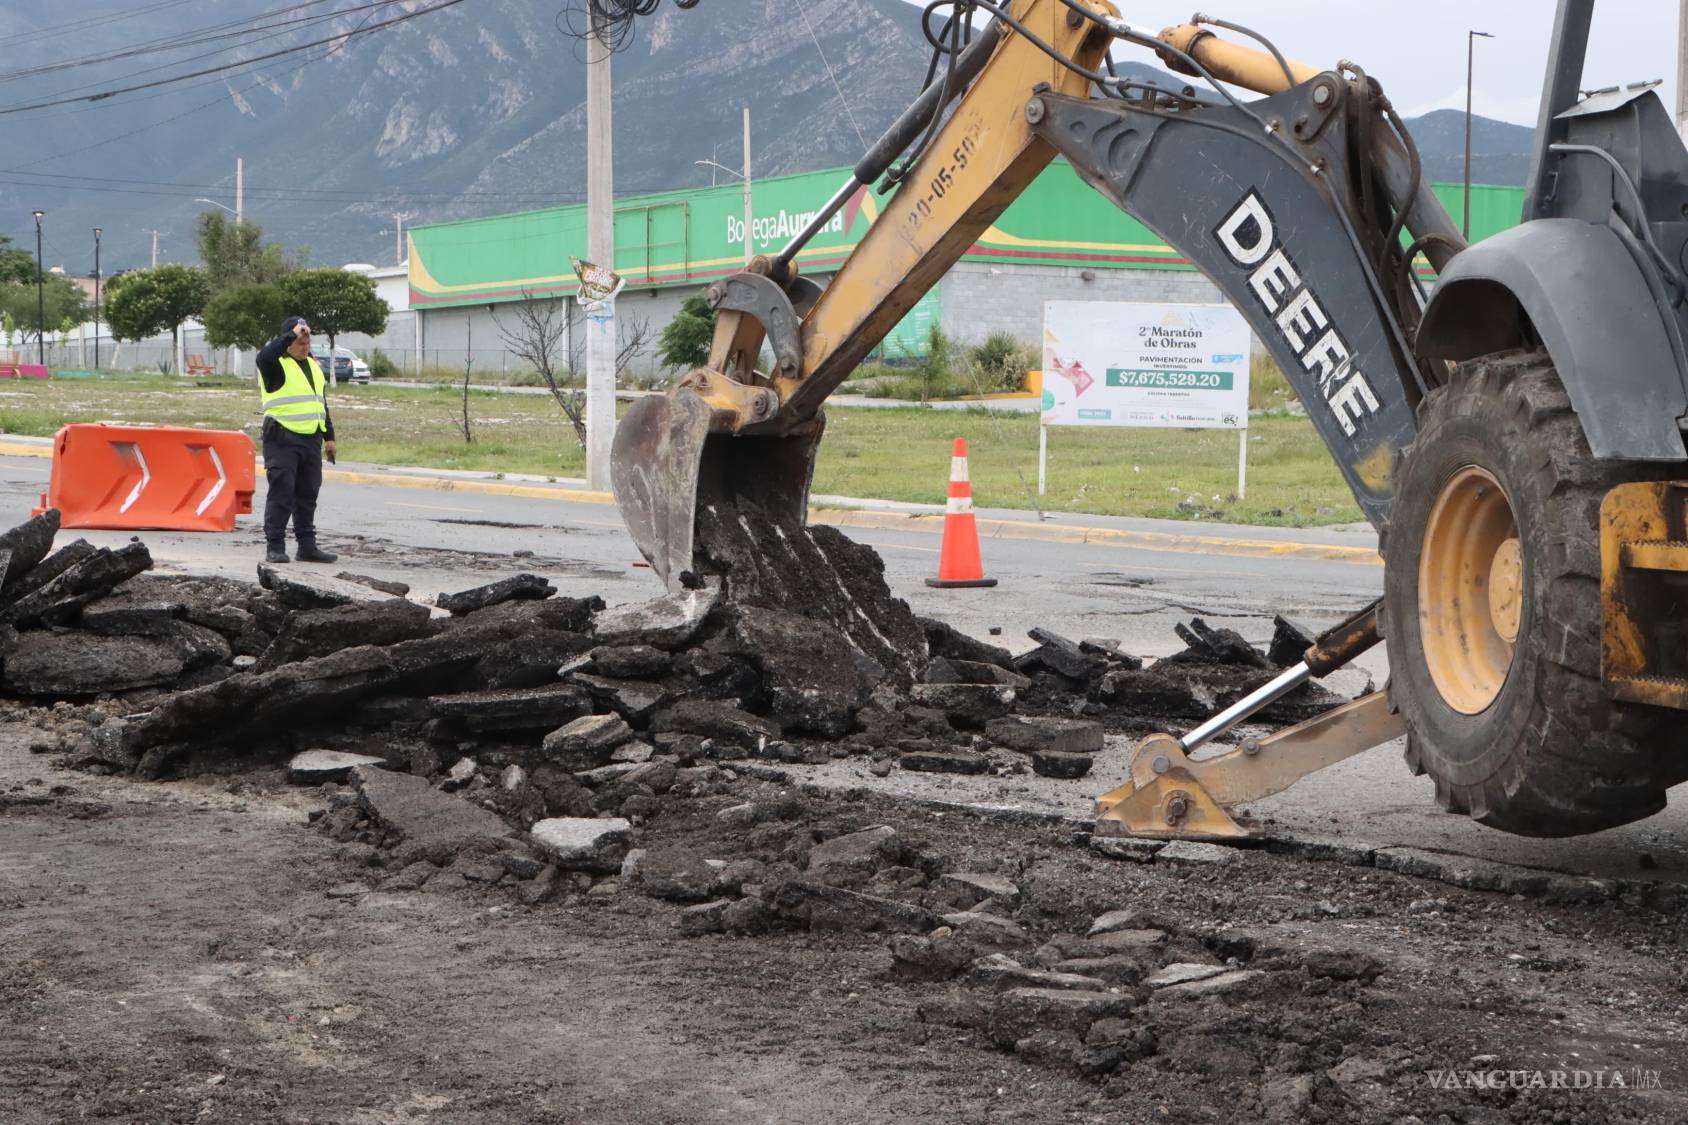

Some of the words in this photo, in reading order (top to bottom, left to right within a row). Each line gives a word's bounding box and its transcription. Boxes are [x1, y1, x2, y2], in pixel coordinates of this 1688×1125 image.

[1214, 190, 1381, 438] DEERE
[1152, 326, 1203, 338] Maratón
[1144, 337, 1158, 348] de
[1160, 337, 1197, 349] Obras
[1139, 355, 1203, 364] PAVIMENTACIÓN
[1119, 371, 1220, 387] $7,675,529.20
